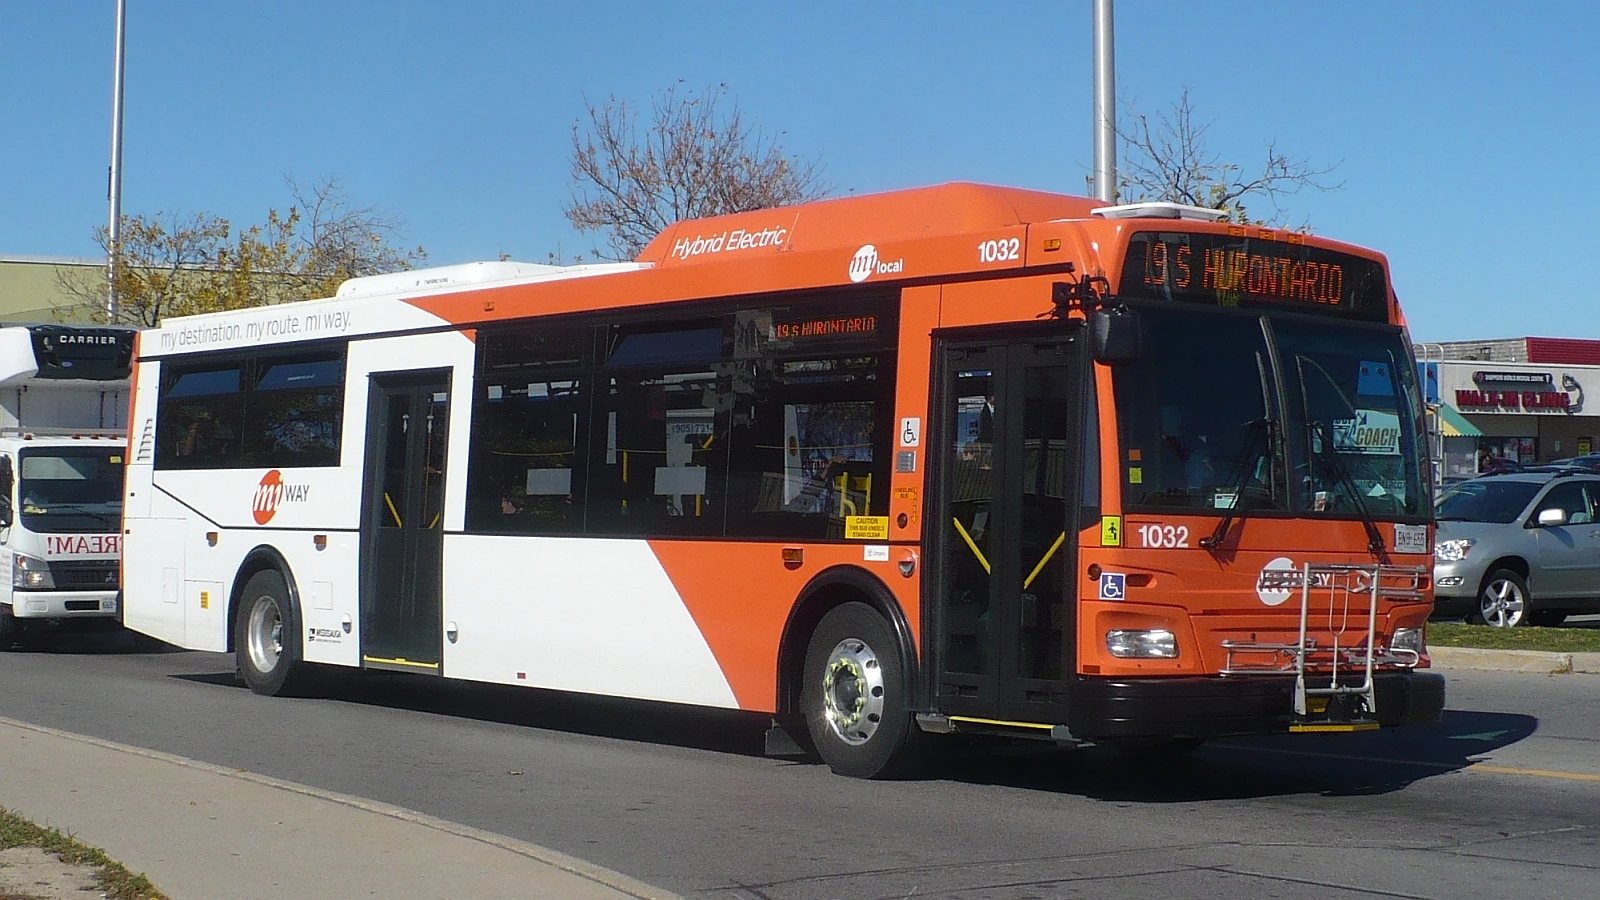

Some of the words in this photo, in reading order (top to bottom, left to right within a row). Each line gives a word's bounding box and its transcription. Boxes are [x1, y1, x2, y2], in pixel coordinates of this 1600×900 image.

[671, 231, 728, 260] Hybrid
[726, 225, 787, 251] Electric
[977, 237, 1020, 262] 1032
[877, 258, 903, 274] local
[1144, 243, 1168, 286] 19
[1175, 245, 1192, 288] S
[1203, 248, 1344, 306] HURONTARIO
[160, 332, 178, 351] my
[179, 322, 242, 346] destination.
[246, 322, 264, 342] my
[266, 315, 301, 336] route.
[305, 310, 321, 331] mi
[324, 310, 351, 332] way.
[801, 316, 876, 335] HURONTARIO
[60, 335, 116, 345] CARRIER
[1456, 390, 1520, 407] WALK-IN
[1522, 391, 1570, 408] CLINIC
[1356, 427, 1397, 446] COACH
[285, 484, 310, 502] WAY
[1138, 525, 1189, 548] 1032
